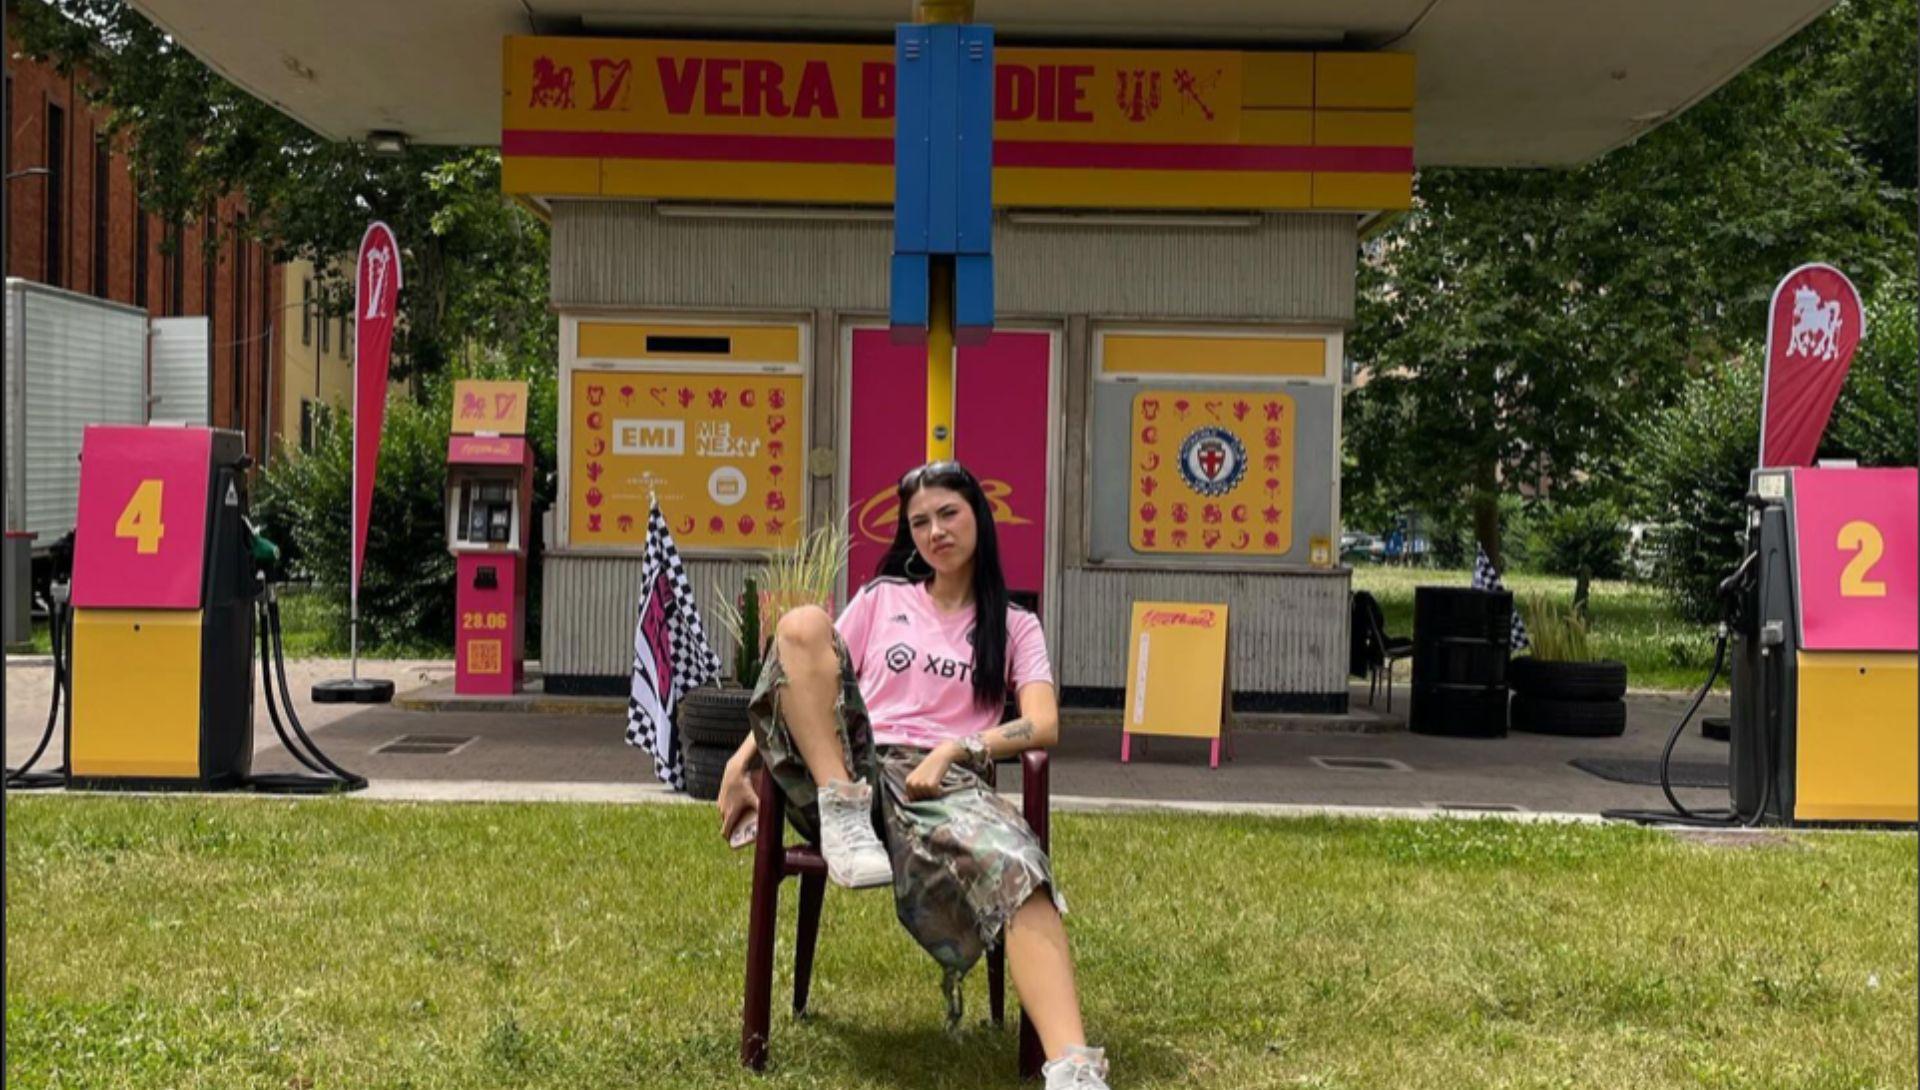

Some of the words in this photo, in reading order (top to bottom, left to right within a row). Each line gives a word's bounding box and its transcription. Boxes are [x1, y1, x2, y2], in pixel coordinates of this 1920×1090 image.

[656, 56, 839, 119] VERA
[861, 61, 1095, 122] BDIE
[621, 426, 677, 448] EMI
[115, 479, 165, 555] 4
[1836, 520, 1887, 597] 2
[462, 611, 508, 630] 28.06
[923, 654, 976, 682] XBT
